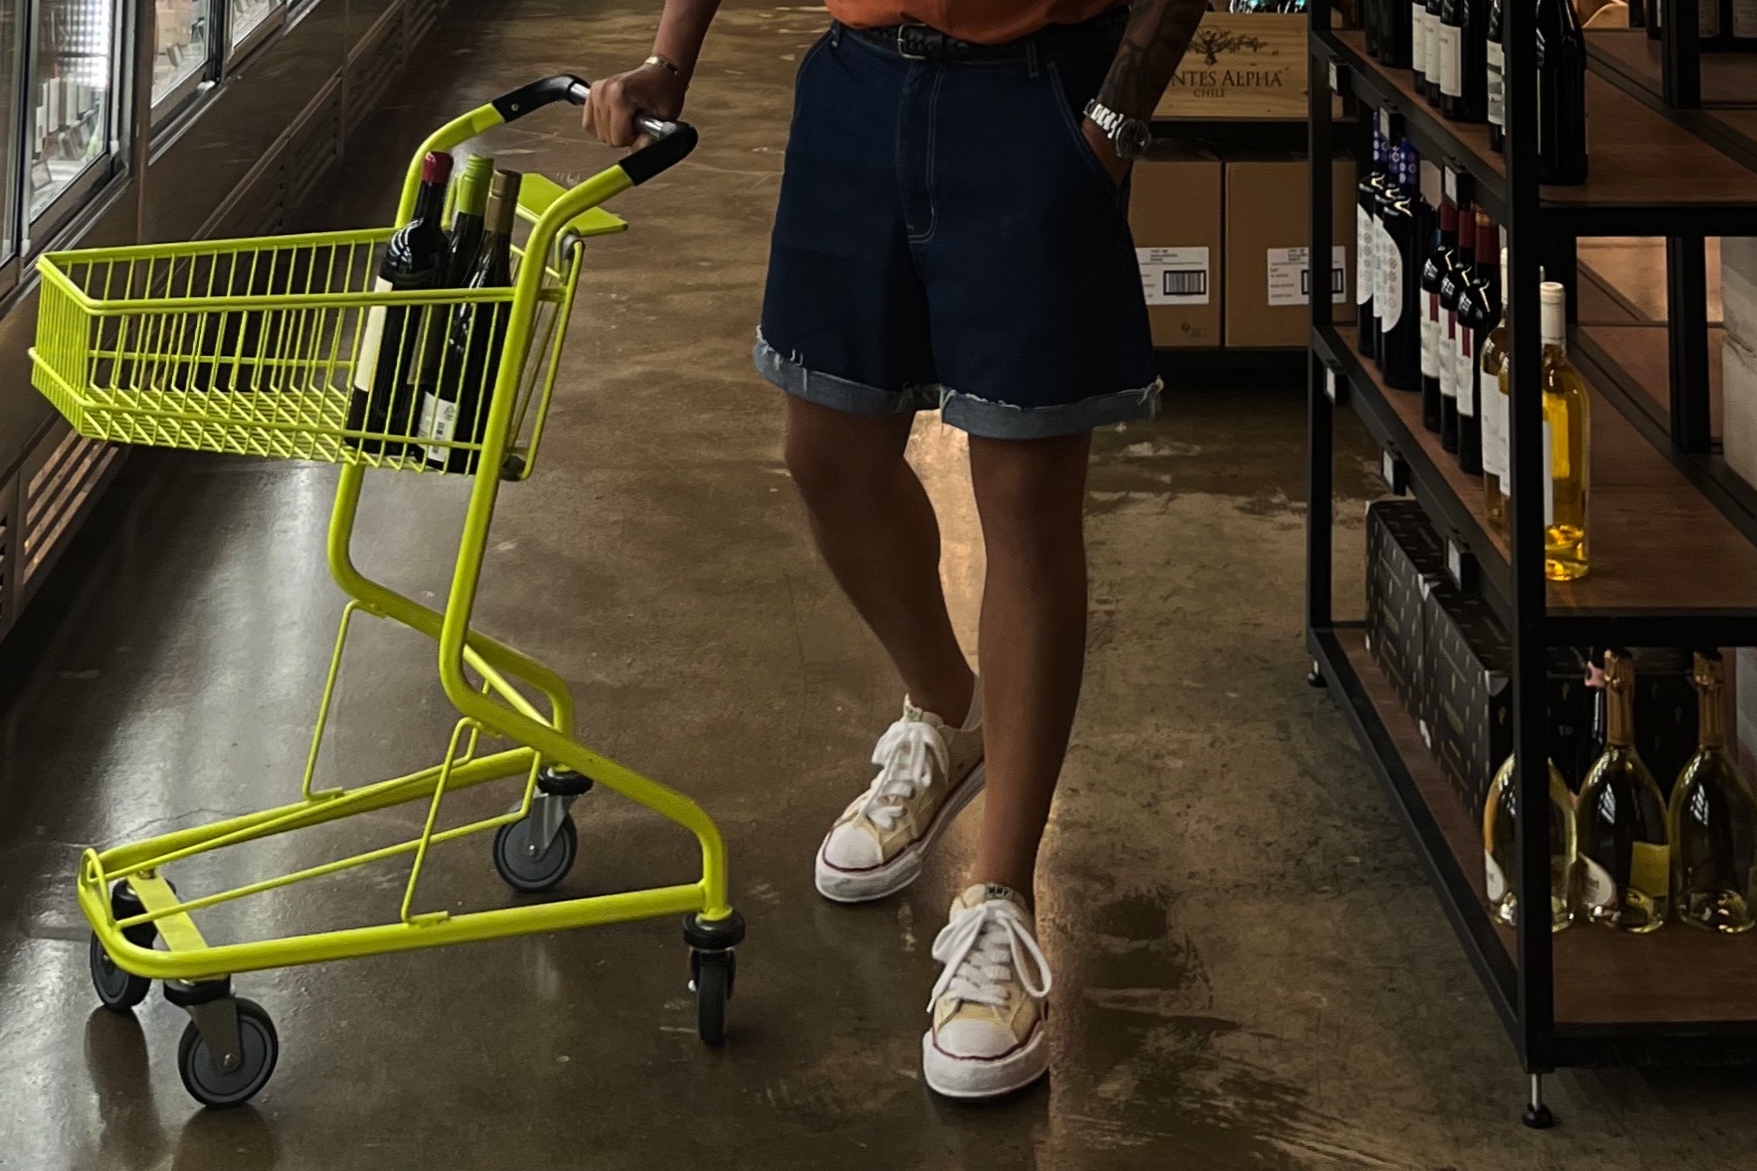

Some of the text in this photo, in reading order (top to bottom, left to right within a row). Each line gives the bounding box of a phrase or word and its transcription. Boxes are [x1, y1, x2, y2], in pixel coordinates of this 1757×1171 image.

[1171, 69, 1282, 87] NTES ALPHA
[1193, 88, 1225, 98] CHILE
